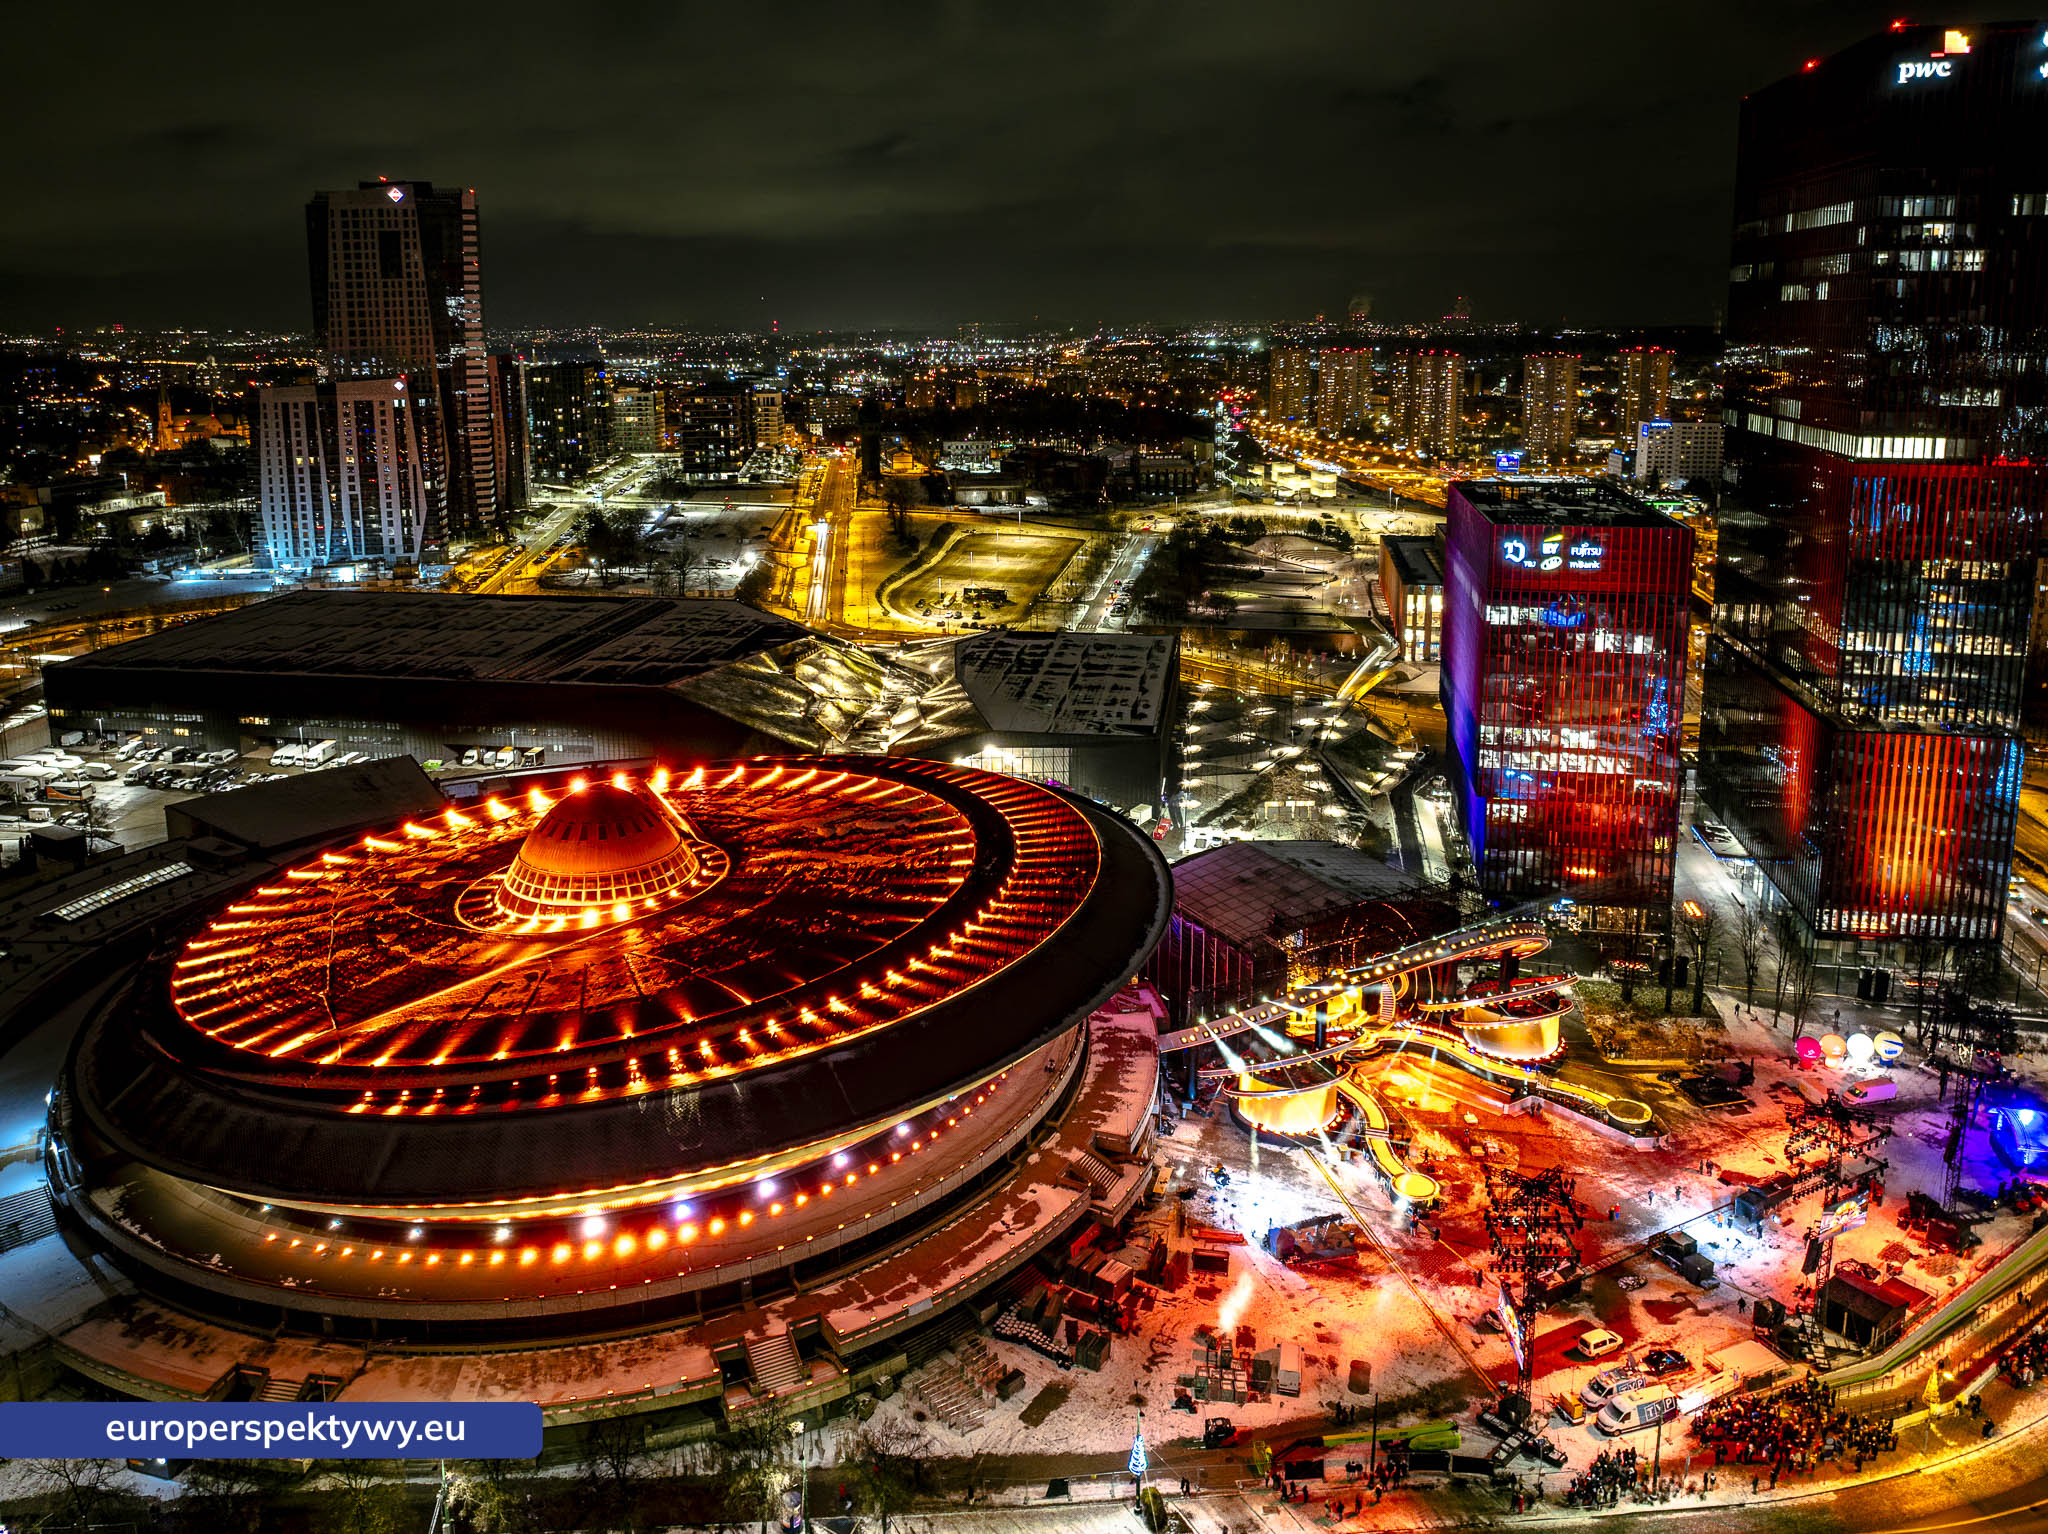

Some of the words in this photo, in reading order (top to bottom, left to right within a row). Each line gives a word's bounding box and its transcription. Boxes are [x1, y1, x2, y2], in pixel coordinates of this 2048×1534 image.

[1898, 61, 1952, 84] pwc
[1570, 545, 1602, 557] FUJITSU
[1569, 560, 1601, 569] mBank
